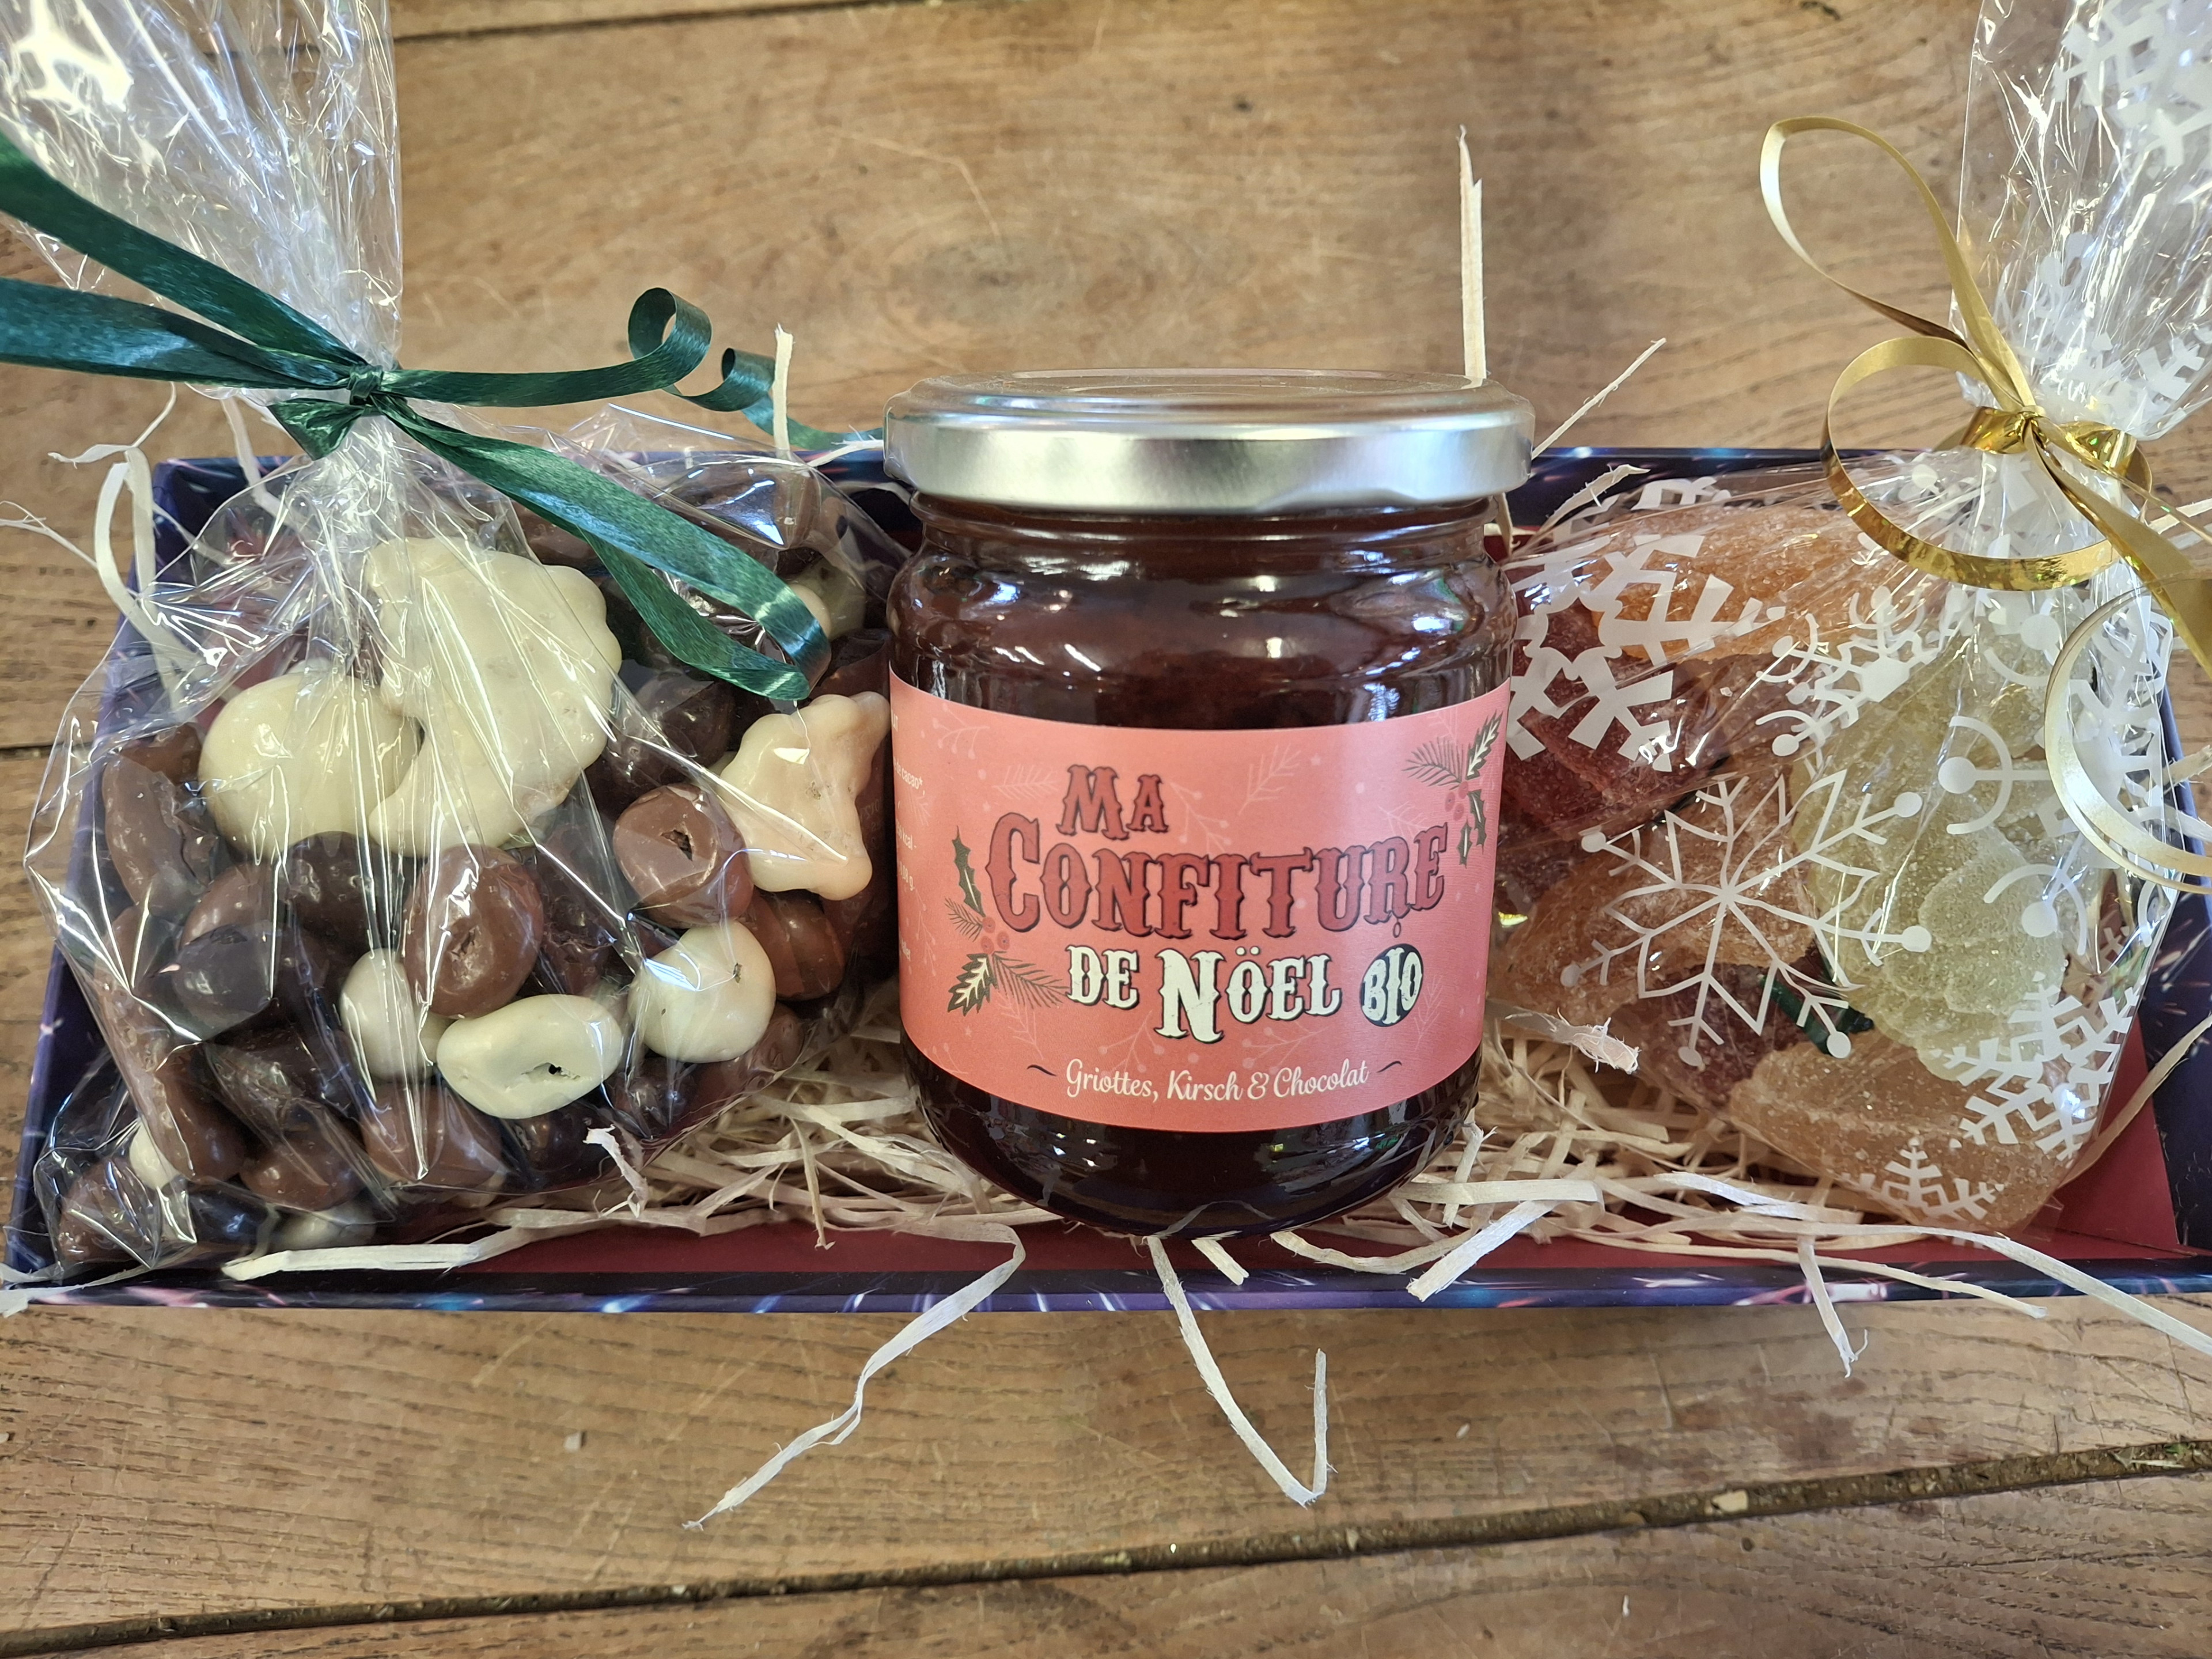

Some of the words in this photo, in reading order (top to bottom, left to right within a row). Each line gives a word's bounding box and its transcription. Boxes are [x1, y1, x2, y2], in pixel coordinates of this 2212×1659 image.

[1056, 765, 1169, 841] MA
[984, 812, 1449, 940] CONFITURE
[1066, 945, 1140, 1009] DE
[1154, 946, 1343, 1043] NÖEL
[1362, 947, 1422, 1025] BIO
[1066, 1058, 1158, 1103] Griottes,
[1166, 1070, 1243, 1101] Kirsch
[1247, 1072, 1270, 1100] &
[1273, 1058, 1370, 1098] Chocolat
